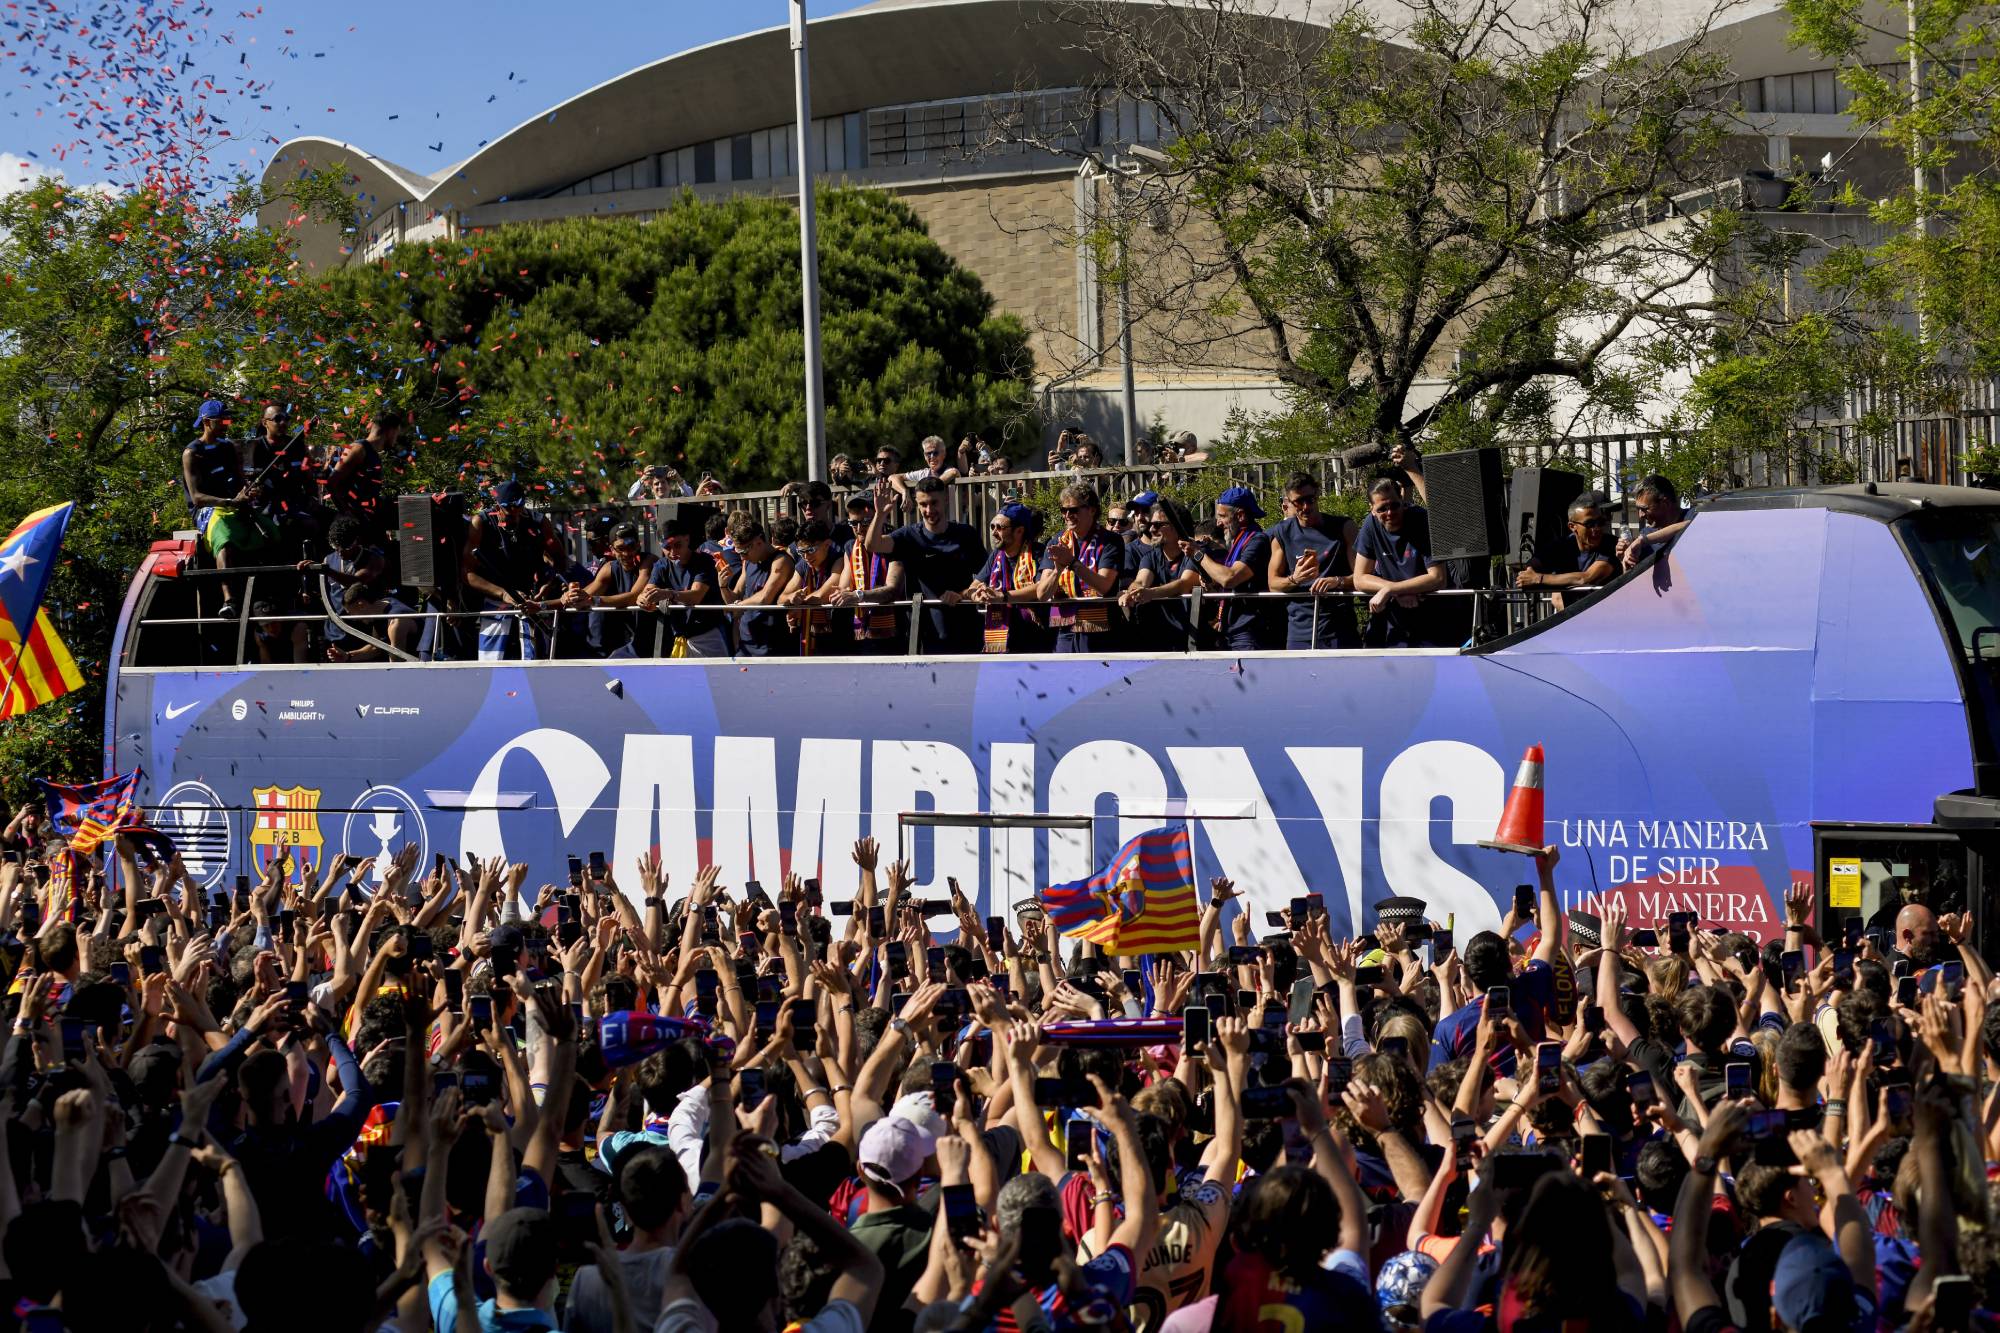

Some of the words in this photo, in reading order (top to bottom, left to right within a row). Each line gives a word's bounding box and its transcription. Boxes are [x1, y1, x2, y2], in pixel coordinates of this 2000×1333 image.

[290, 700, 315, 708] PHILIPS
[373, 706, 420, 715] CUPRA
[278, 711, 317, 720] AMBILIGHT
[1563, 819, 1629, 848] UNA
[1638, 820, 1769, 850] MANERA
[1610, 855, 1648, 884] DE
[1657, 856, 1721, 886] SER
[1563, 890, 1628, 917] UNA
[1638, 892, 1769, 923] MANERA
